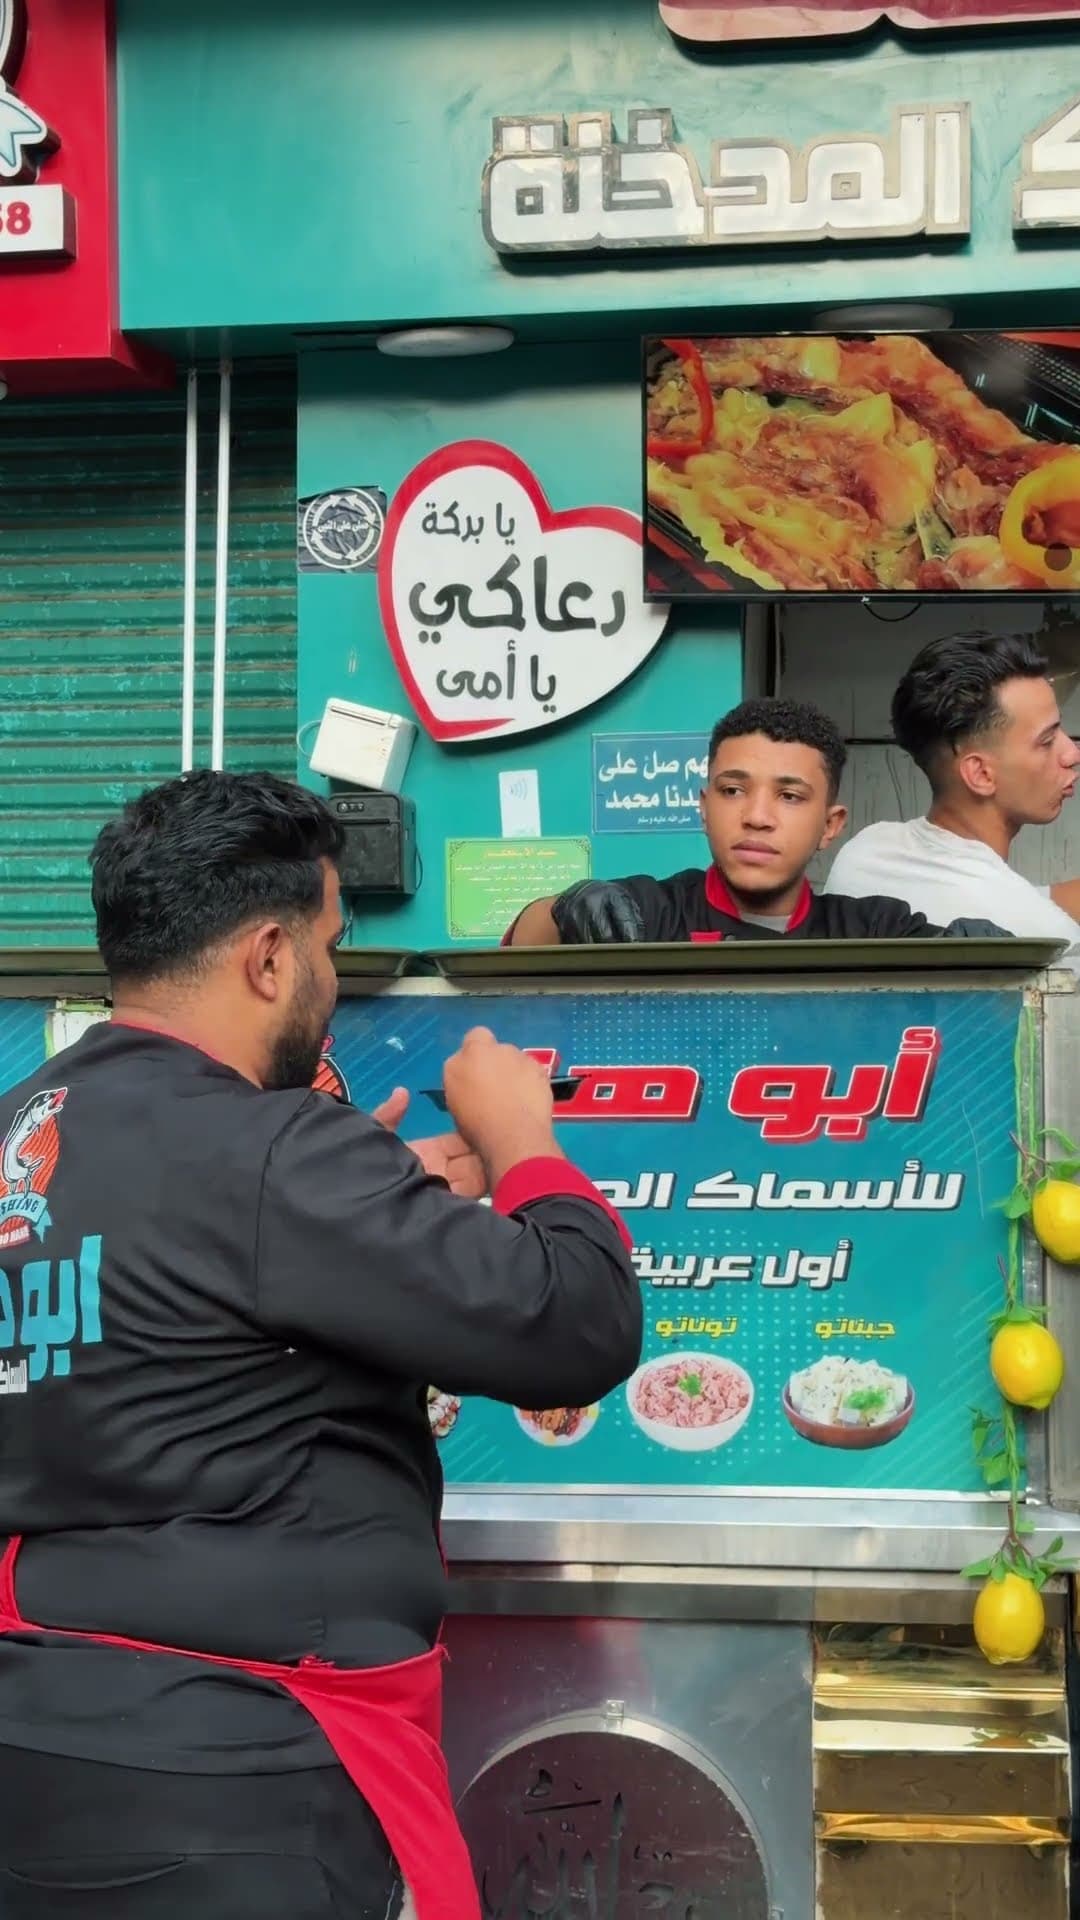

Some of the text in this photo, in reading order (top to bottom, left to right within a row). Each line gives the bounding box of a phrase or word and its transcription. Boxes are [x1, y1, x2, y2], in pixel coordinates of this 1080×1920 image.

[482, 102, 970, 254] المدخنة
[422, 501, 515, 545] يا بركة
[409, 554, 626, 644] رعاكي
[530, 654, 557, 713] يا
[606, 785, 701, 813] يدنا محمد
[728, 1026, 941, 1141] أبو
[0, 1198, 38, 1215] SHING
[592, 1160, 963, 1210] للأسماك الم
[631, 1239, 852, 1290] أول عربية
